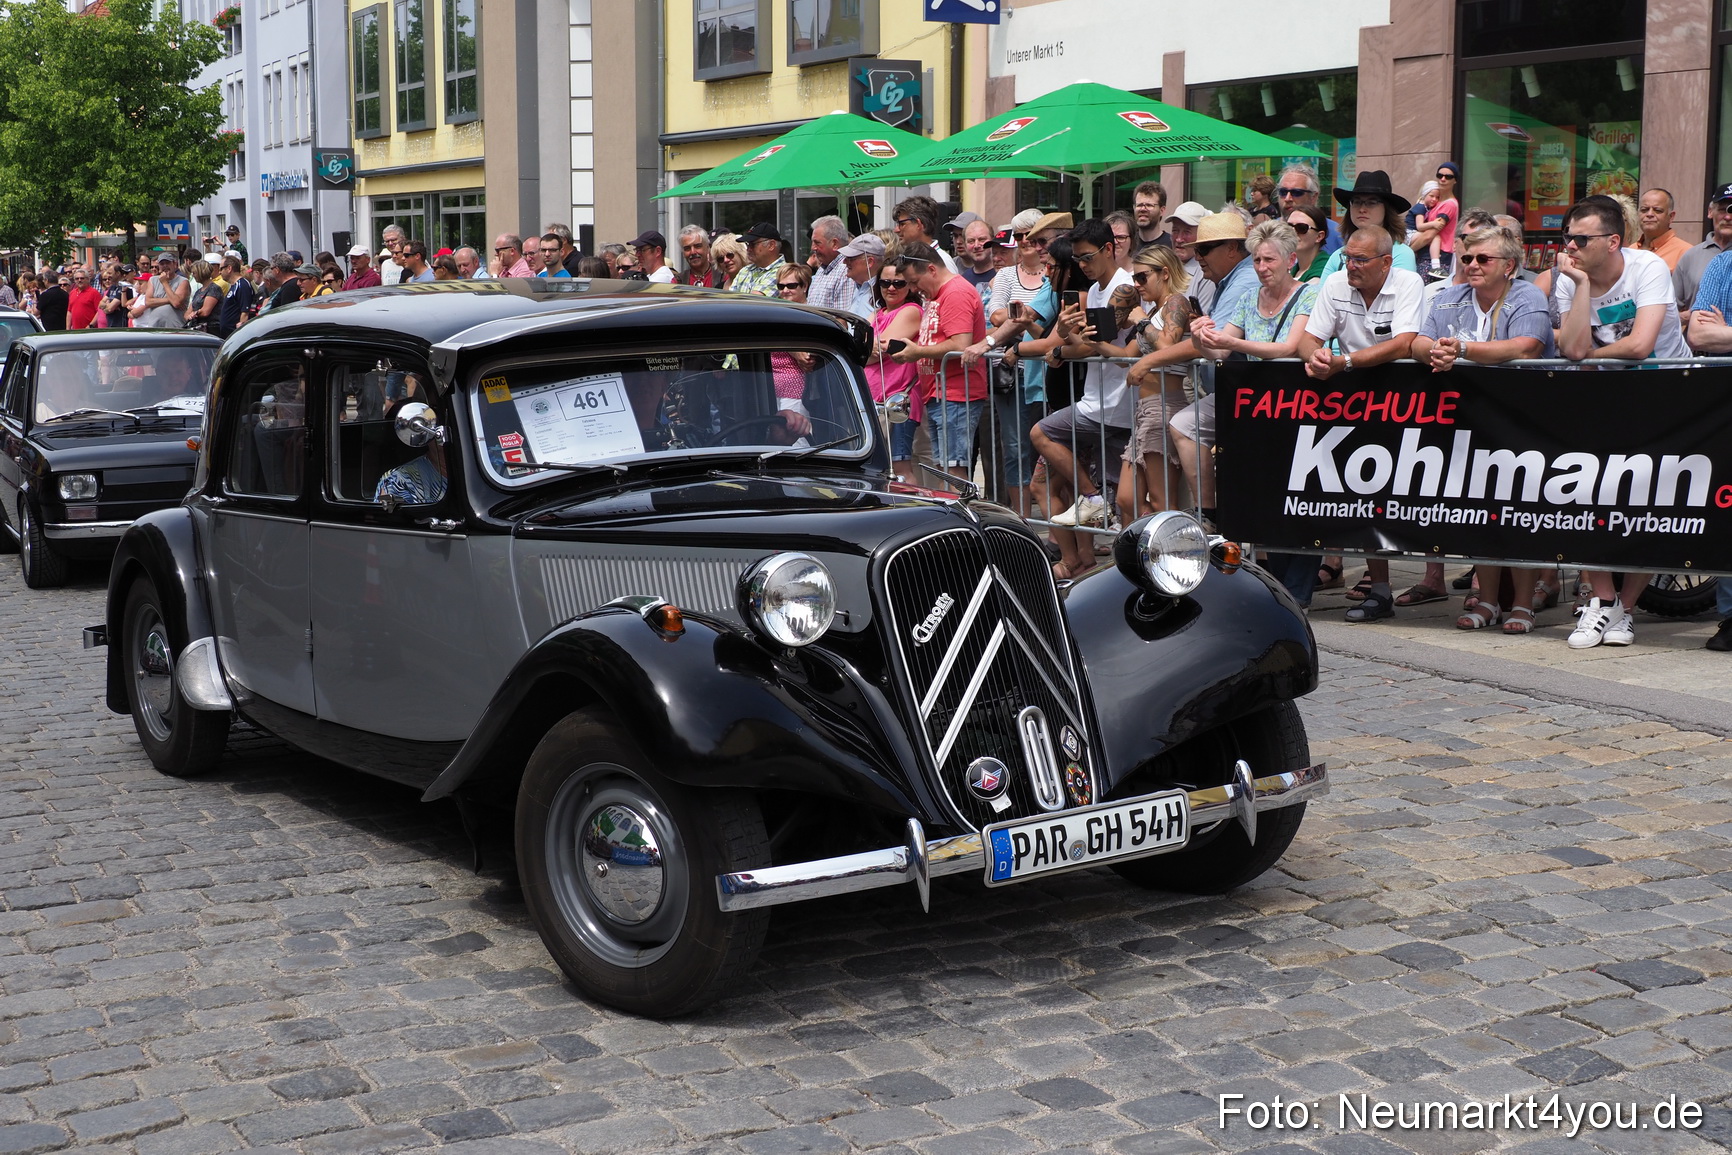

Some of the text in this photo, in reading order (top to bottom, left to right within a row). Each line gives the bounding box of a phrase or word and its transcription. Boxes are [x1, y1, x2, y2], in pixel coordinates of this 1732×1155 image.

[1007, 41, 1064, 64] Unterer Markt 15
[880, 81, 905, 113] G2
[1128, 134, 1213, 144] Neumarkter
[1595, 131, 1635, 144] Grillen
[949, 143, 1017, 155] Neumarkter
[1123, 142, 1243, 155] Lammsbräu
[328, 159, 343, 177] G2
[920, 151, 1013, 167] Lammsbräu
[484, 378, 506, 389] ADAC
[573, 389, 609, 410] 461
[1234, 388, 1461, 425] FAHRSCHULE
[1287, 424, 1713, 507] Kohlmann
[1284, 496, 1706, 537] Neumarkt Burgthann Freystadt Pyrbaum
[999, 801, 1183, 871] D PAR GH 54H
